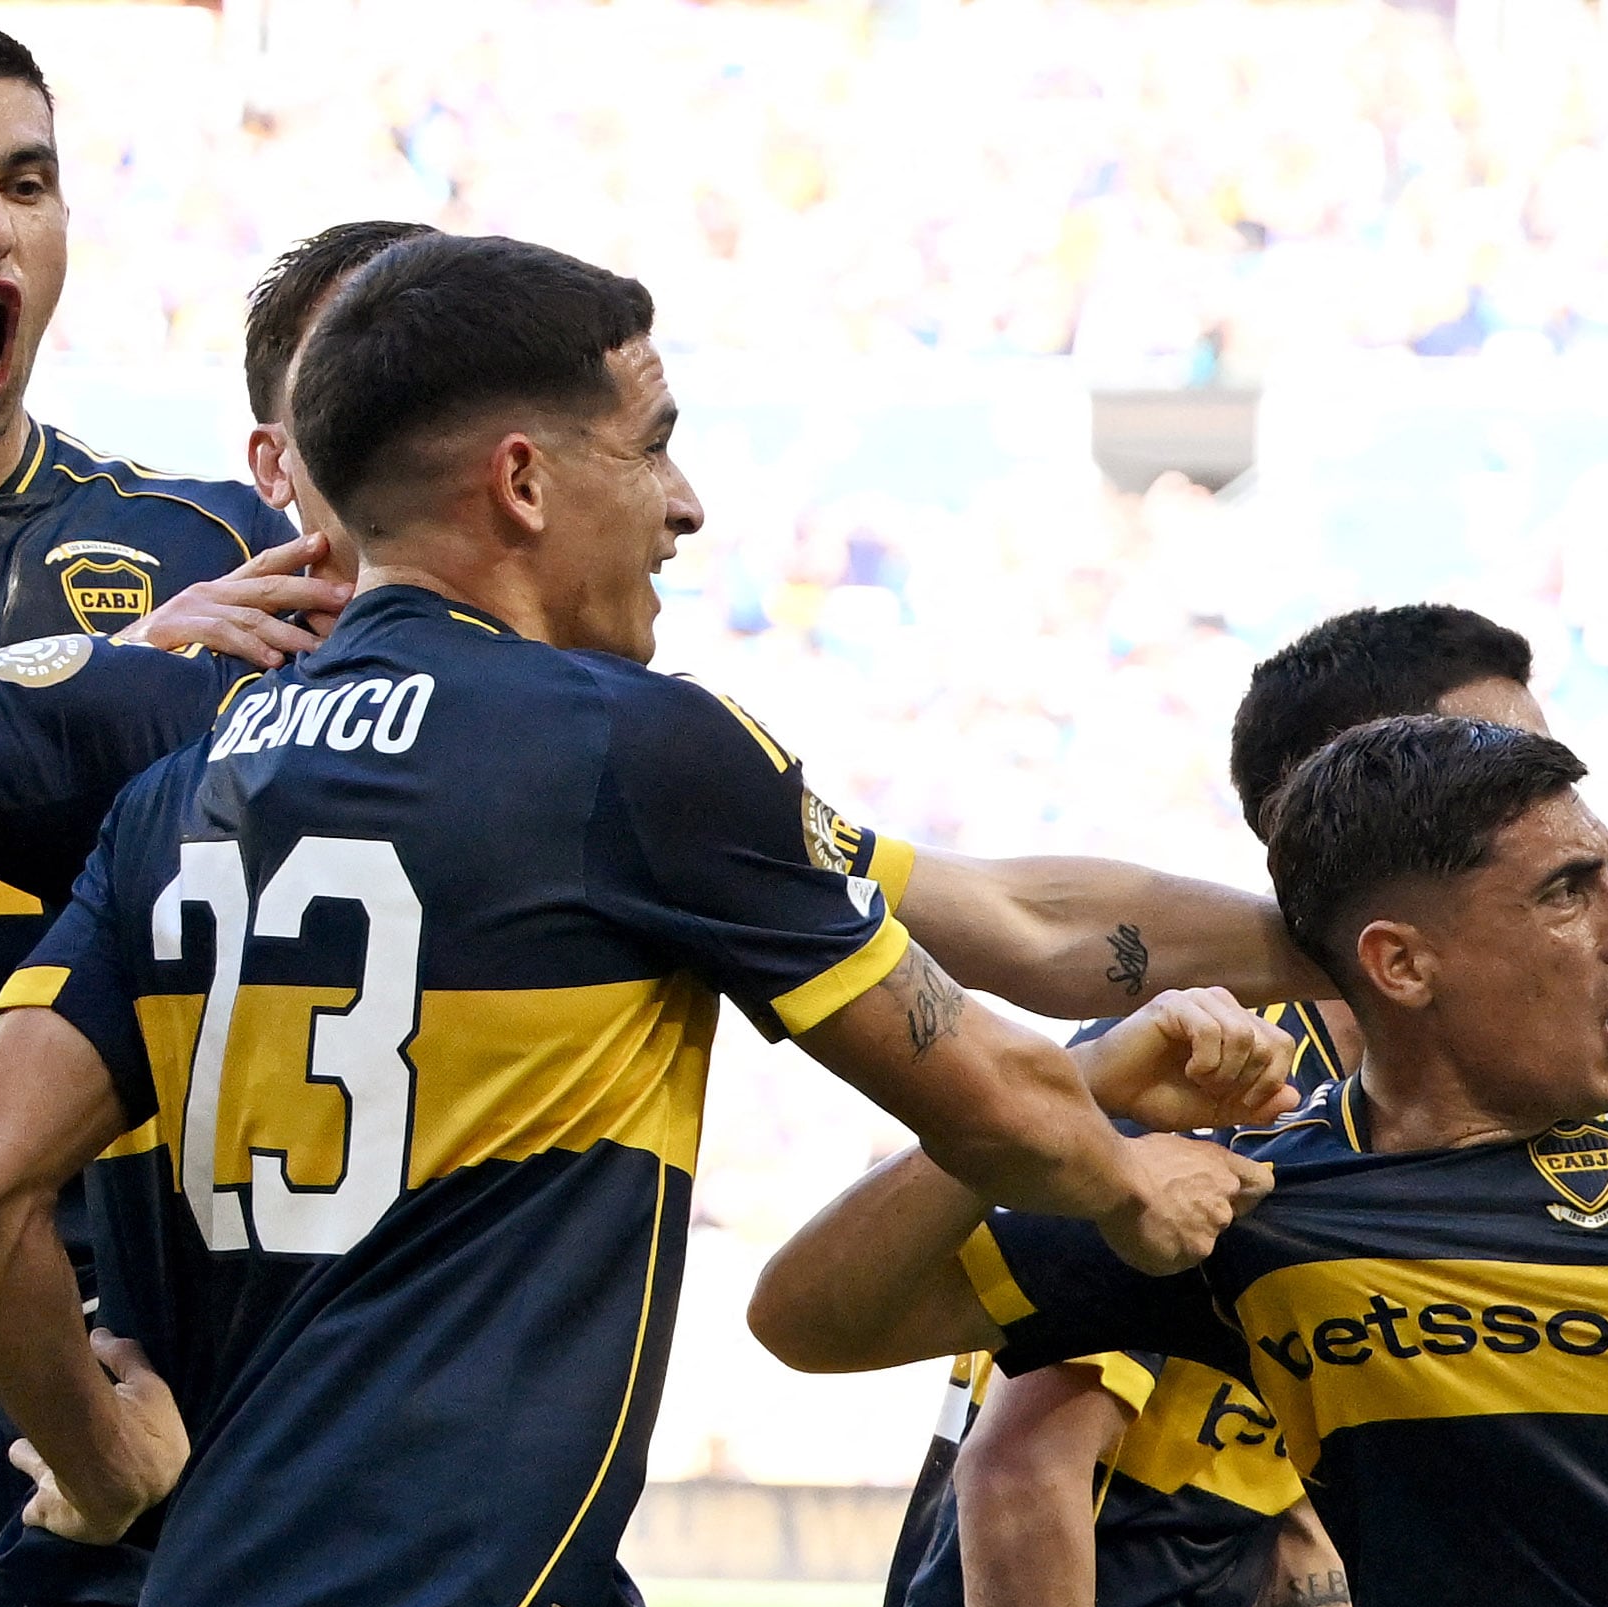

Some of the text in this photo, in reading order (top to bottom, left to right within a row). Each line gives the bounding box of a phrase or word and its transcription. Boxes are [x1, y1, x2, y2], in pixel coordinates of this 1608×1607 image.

[80, 592, 139, 609] CABJ
[208, 673, 436, 762] BLANCO
[151, 835, 424, 1255] 23
[1547, 1152, 1608, 1170] CABJ
